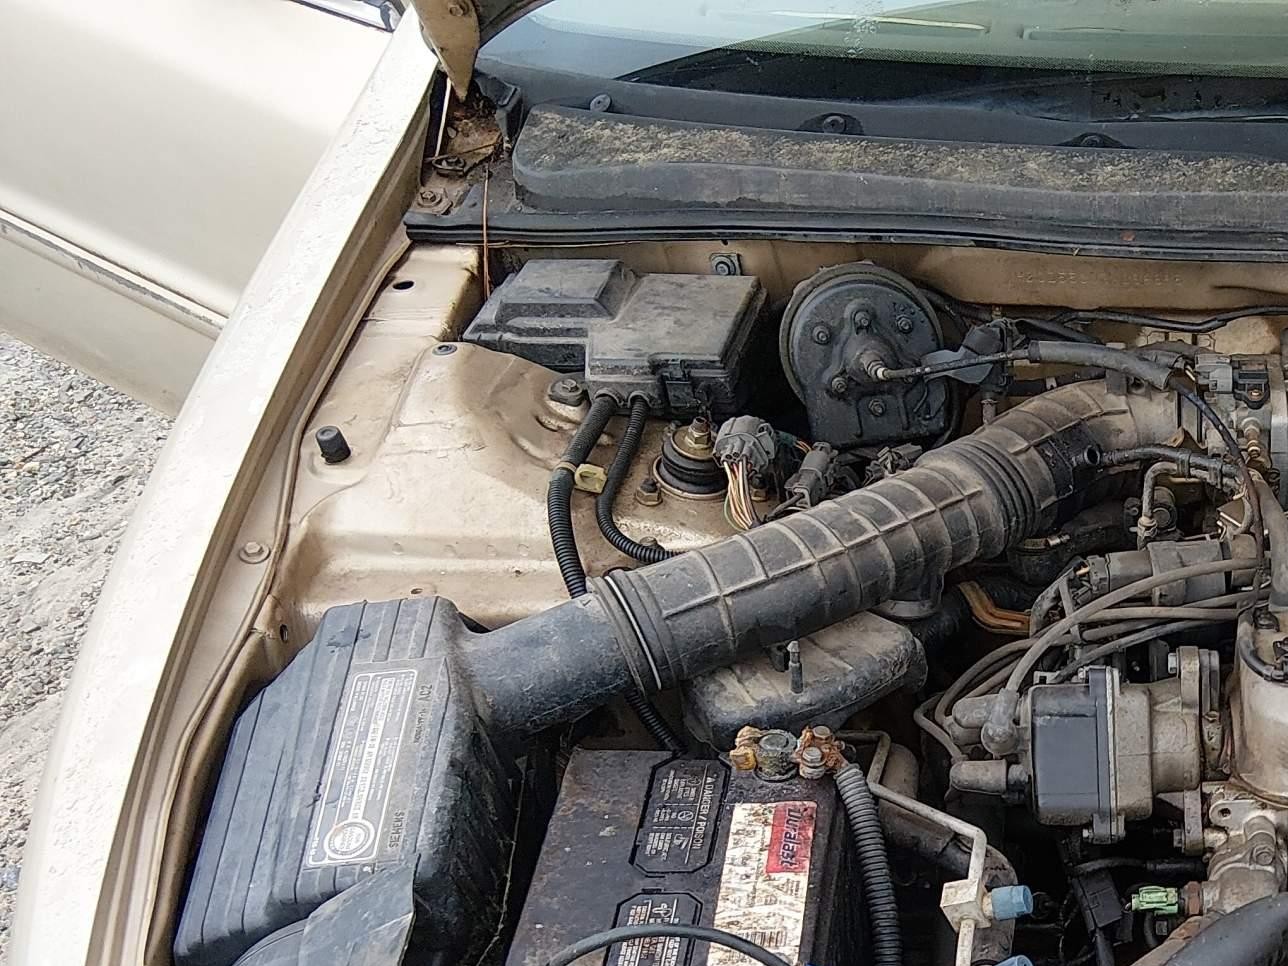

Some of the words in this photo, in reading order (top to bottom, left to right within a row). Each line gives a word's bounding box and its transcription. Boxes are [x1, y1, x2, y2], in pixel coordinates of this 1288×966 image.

[700, 784, 713, 815] DANGER
[388, 811, 405, 849] SIEMENS
[692, 821, 707, 850] POISON
